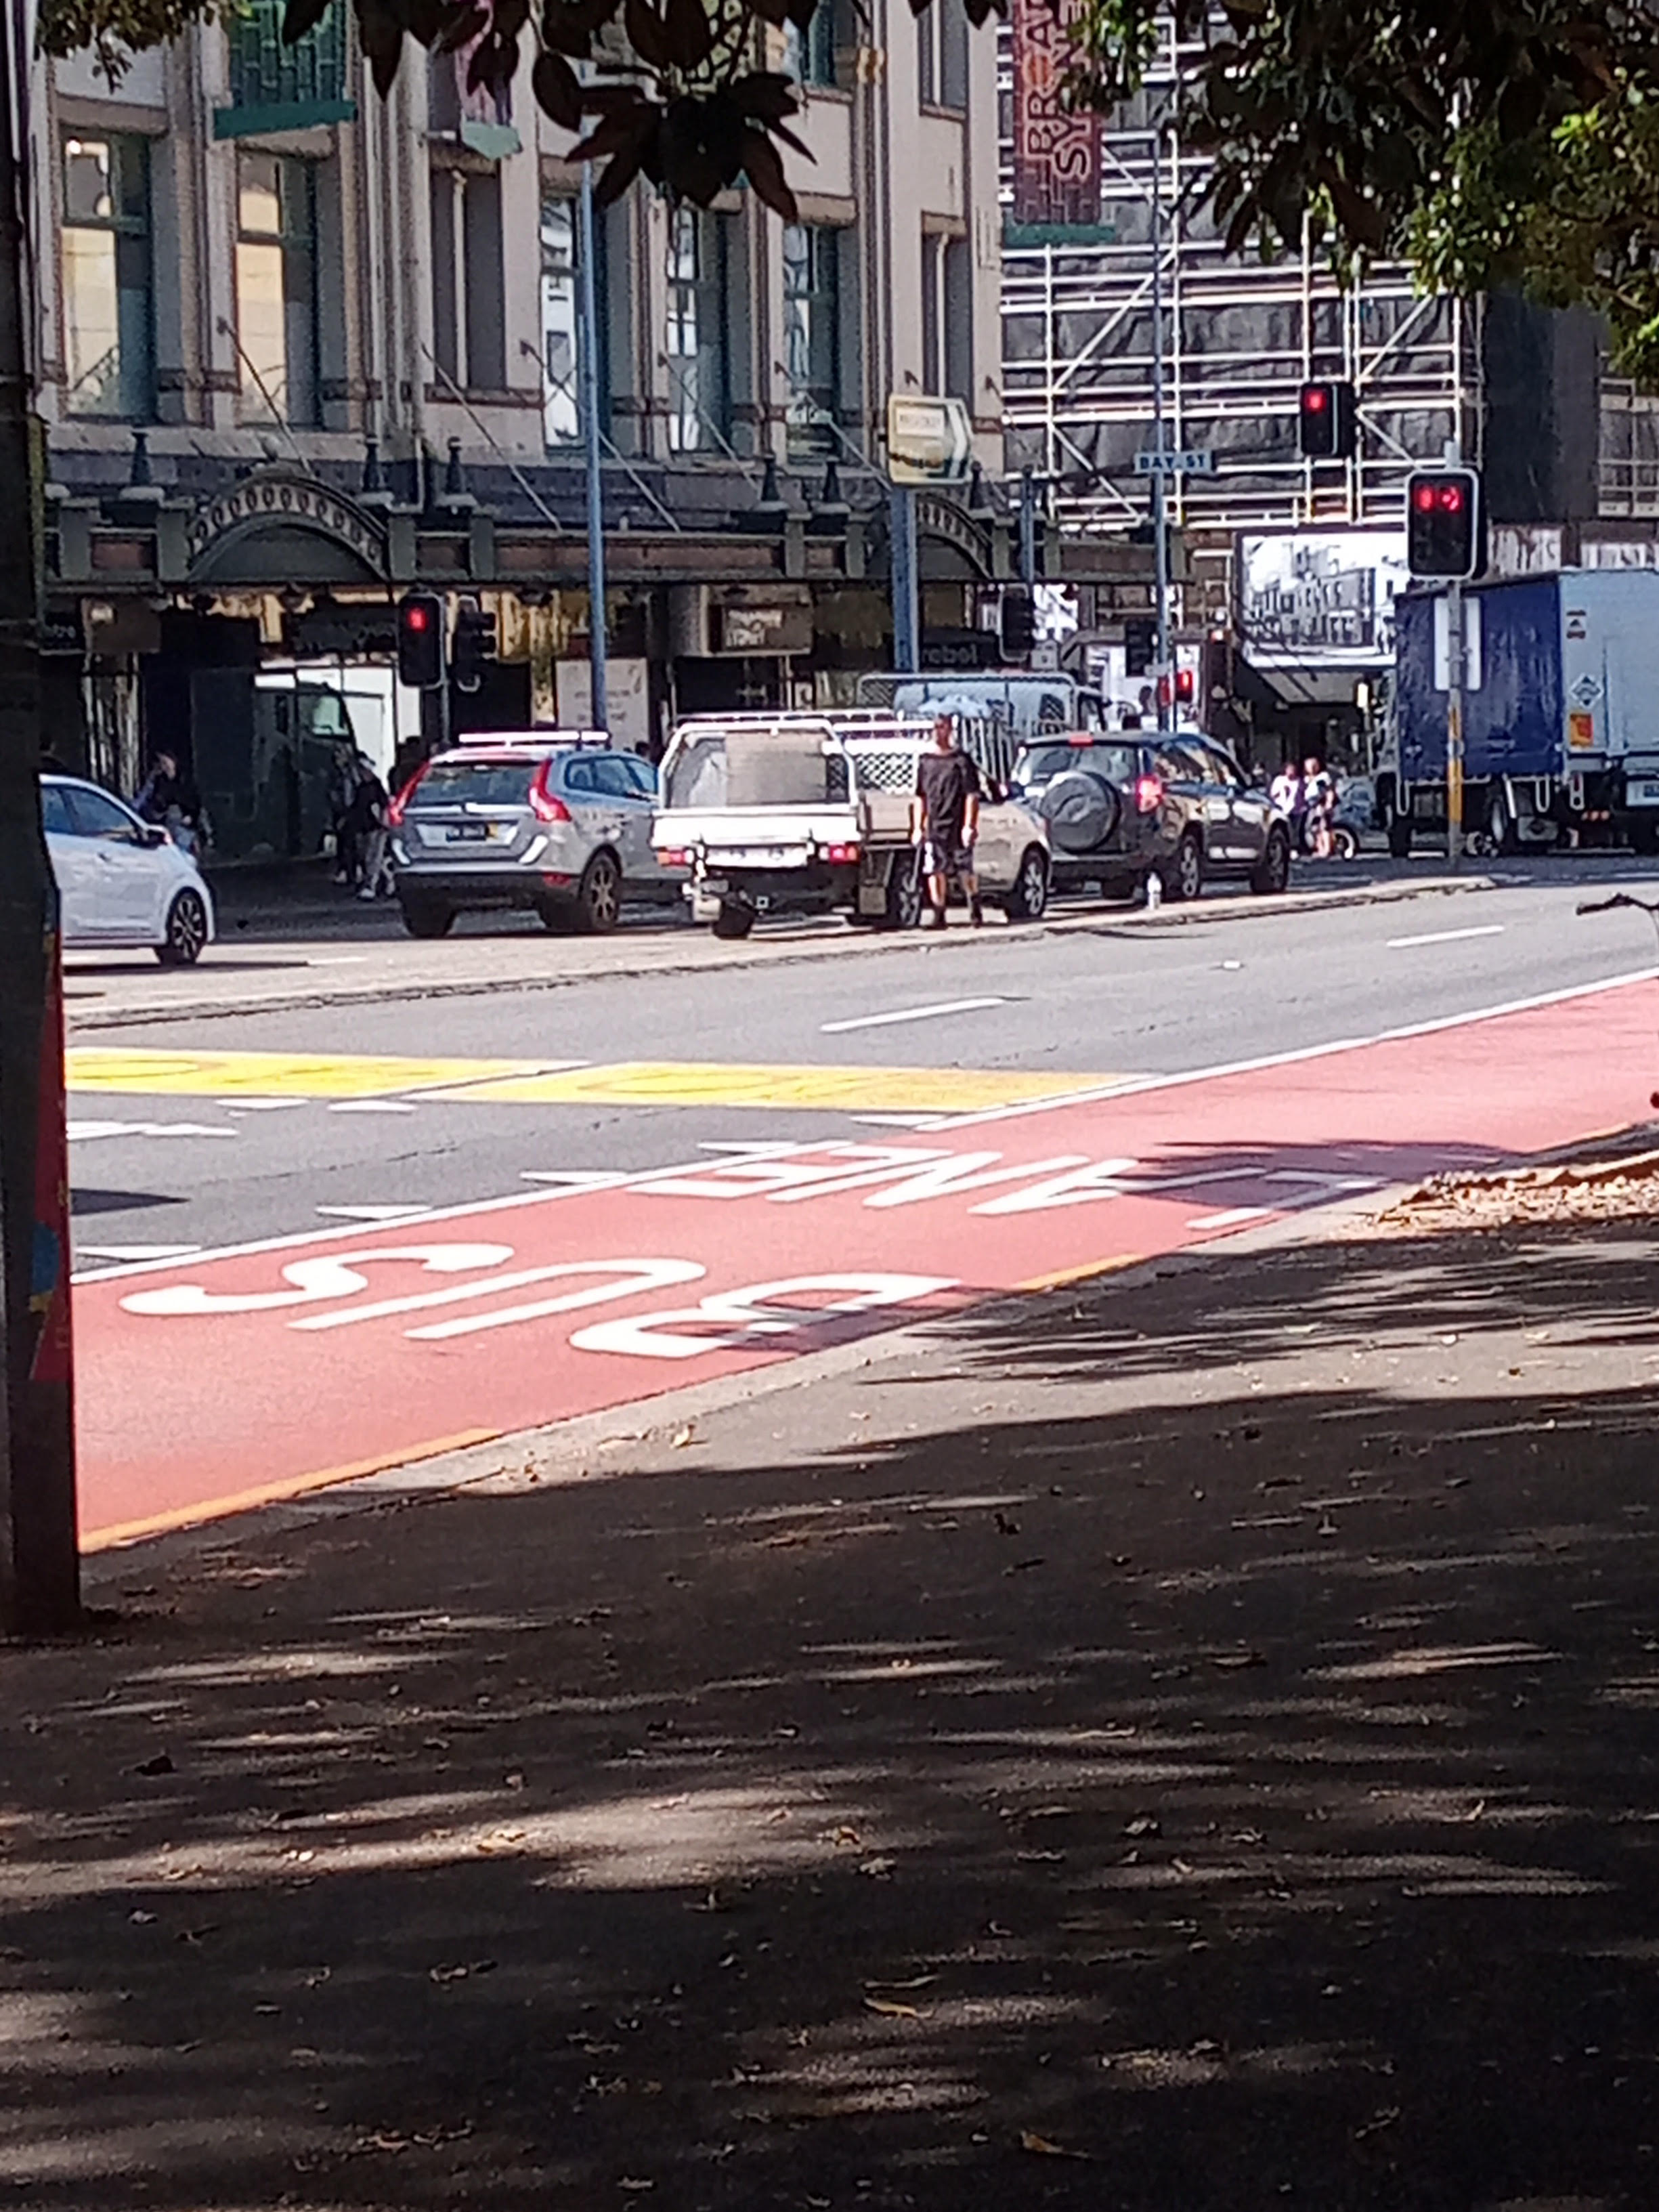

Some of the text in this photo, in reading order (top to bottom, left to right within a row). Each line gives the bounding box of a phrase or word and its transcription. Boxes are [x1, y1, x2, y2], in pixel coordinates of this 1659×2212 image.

[1186, 454, 1205, 468] ST
[622, 1143, 1389, 1232] LANE
[118, 1243, 962, 1359] BUS
